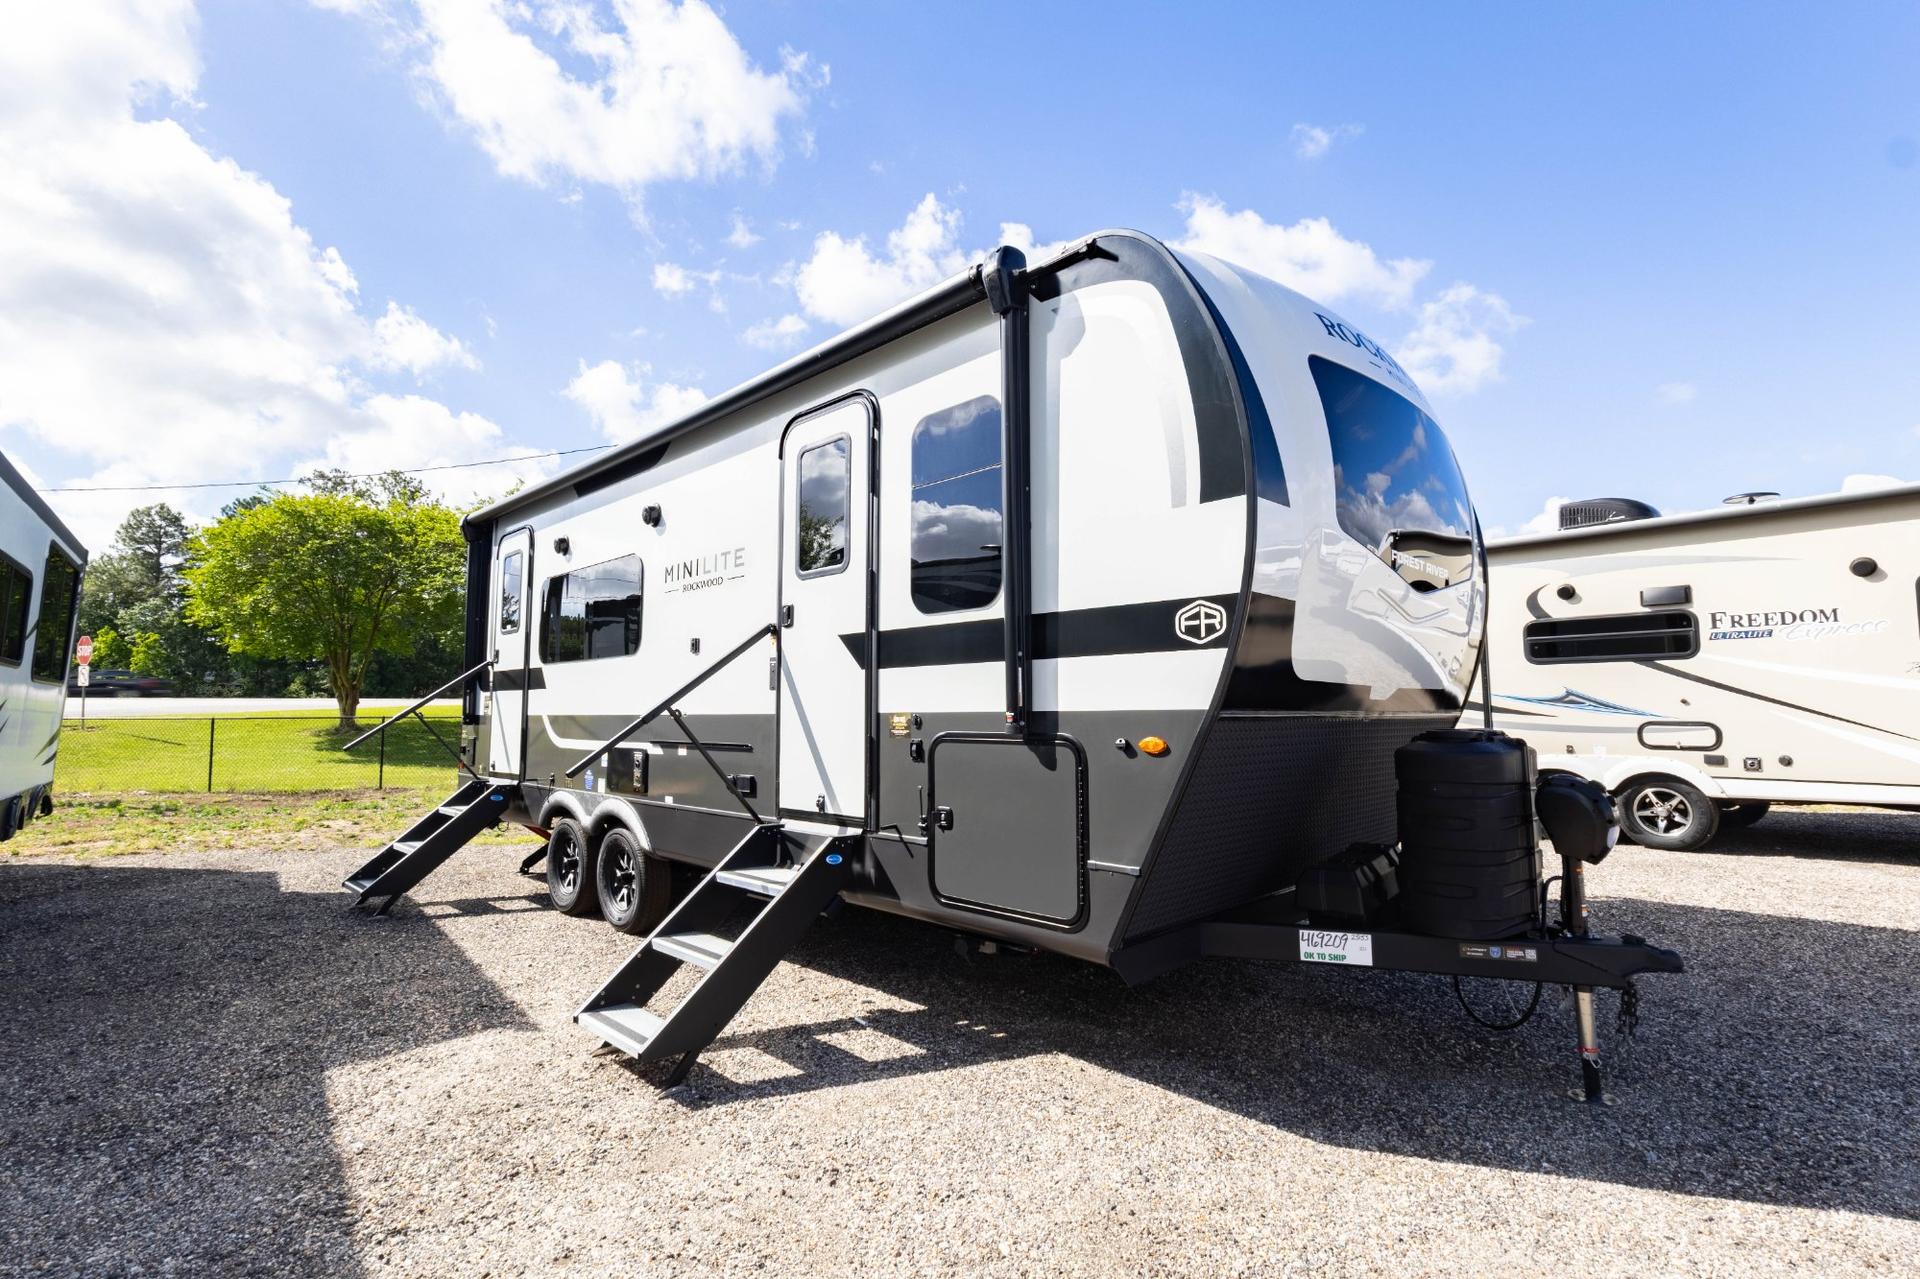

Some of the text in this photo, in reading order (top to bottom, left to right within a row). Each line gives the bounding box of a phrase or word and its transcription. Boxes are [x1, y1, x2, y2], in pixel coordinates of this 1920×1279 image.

[1391, 549, 1449, 580] FOREST RIVER
[682, 576, 724, 593] ROCKWOOD
[1710, 607, 1840, 630] FREEDOM
[77, 645, 92, 657] STOP
[1300, 931, 1349, 952] 469209
[1303, 951, 1347, 962] OK TO SHIP
